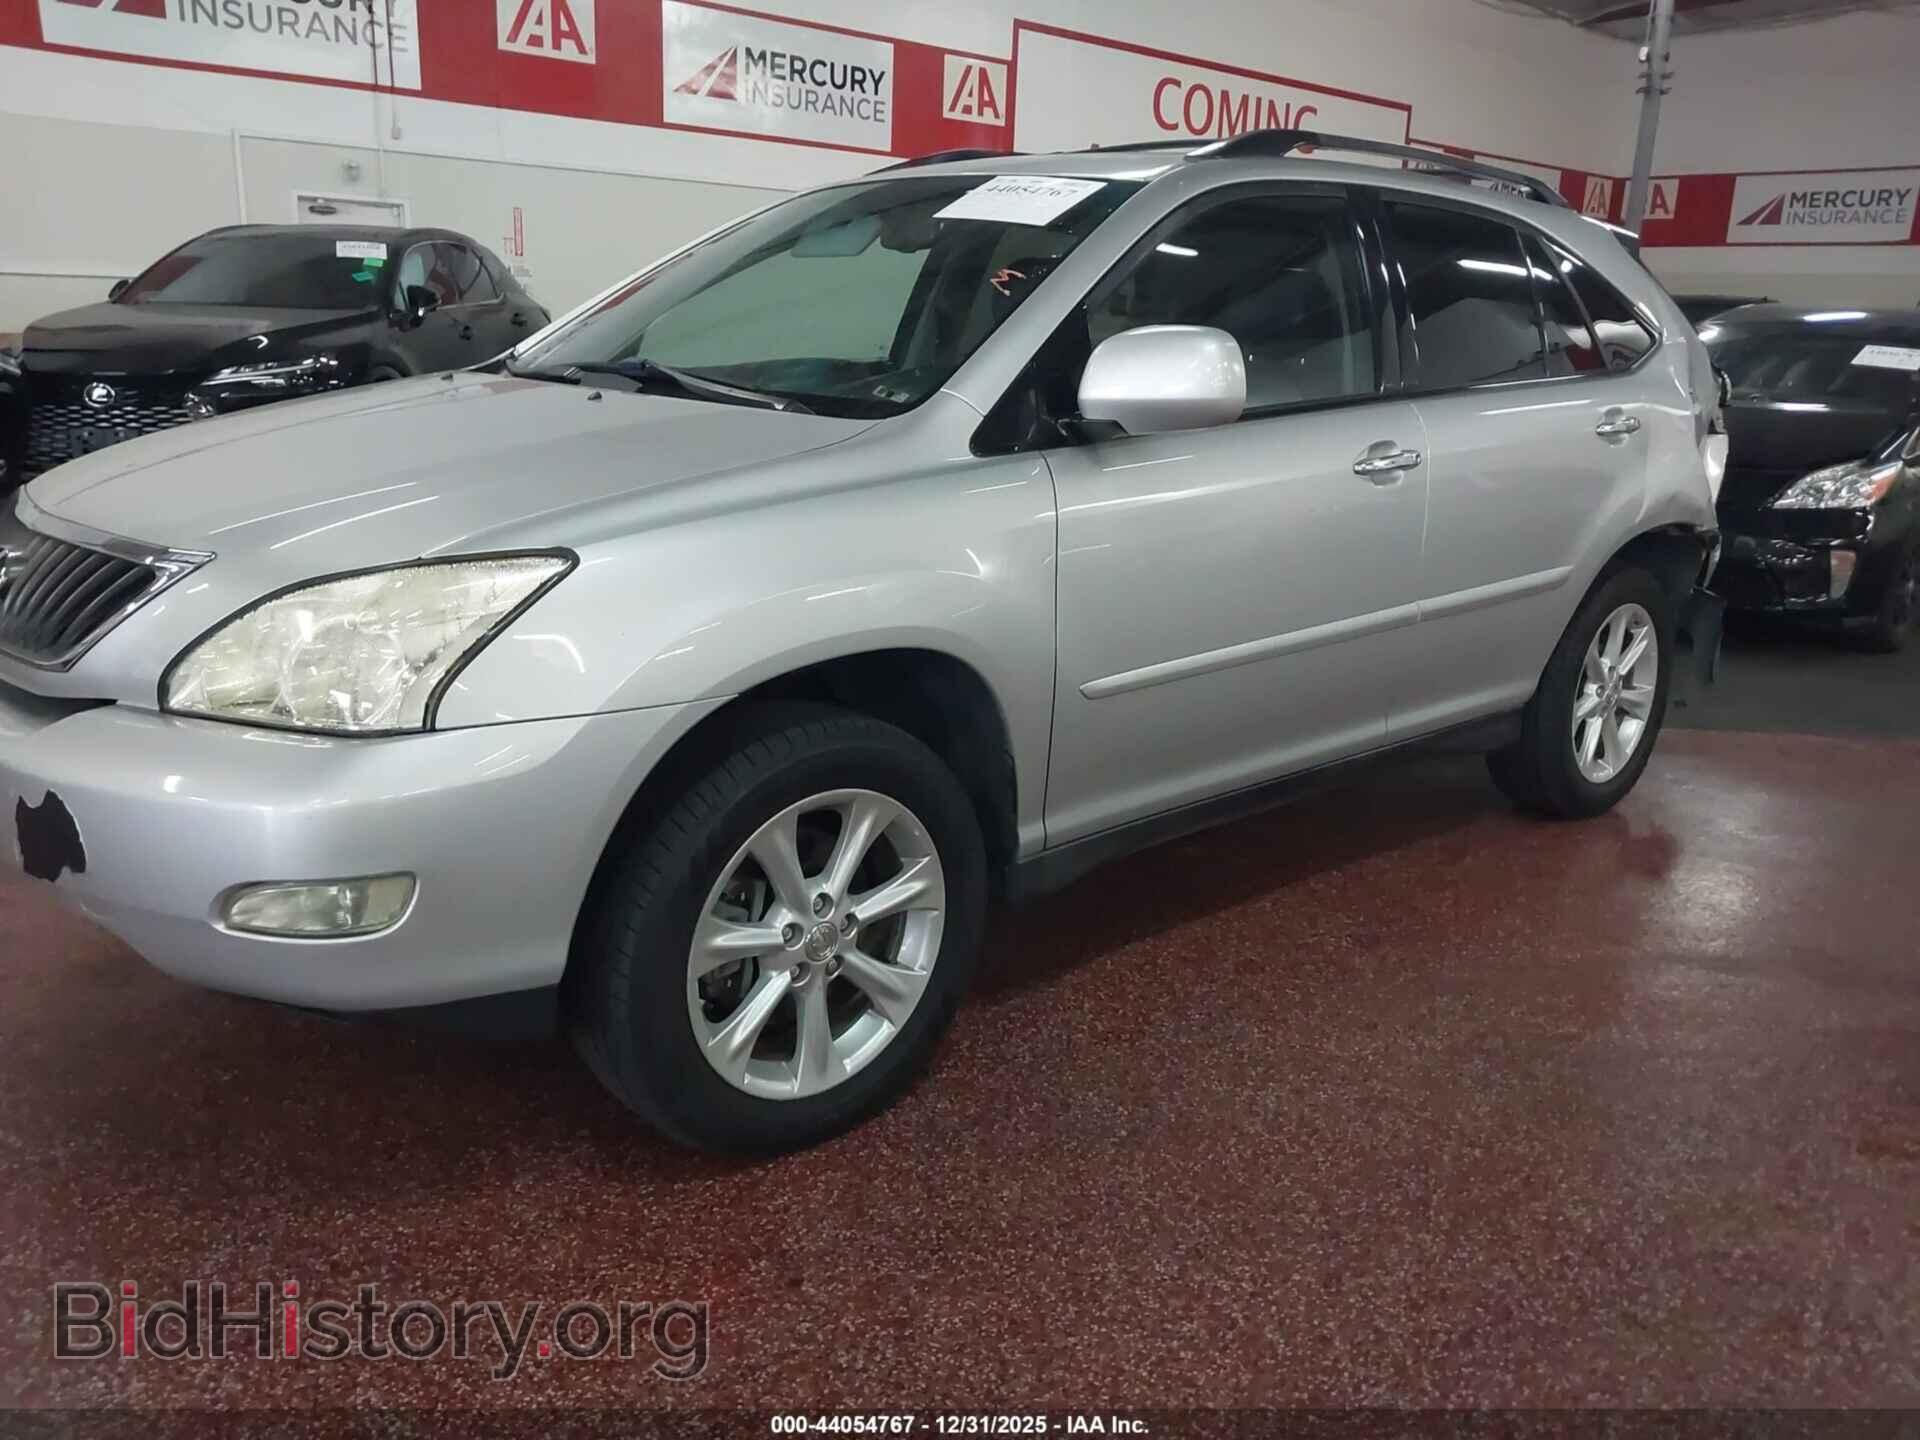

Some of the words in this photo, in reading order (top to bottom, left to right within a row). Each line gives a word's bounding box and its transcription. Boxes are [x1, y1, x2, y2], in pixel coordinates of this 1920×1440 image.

[178, 0, 409, 53] INSURANCE
[744, 47, 886, 97] MERCURY
[744, 85, 886, 124] INSURANCE
[1786, 208, 1908, 225] INSURANCE
[1789, 188, 1912, 208] MERCURY
